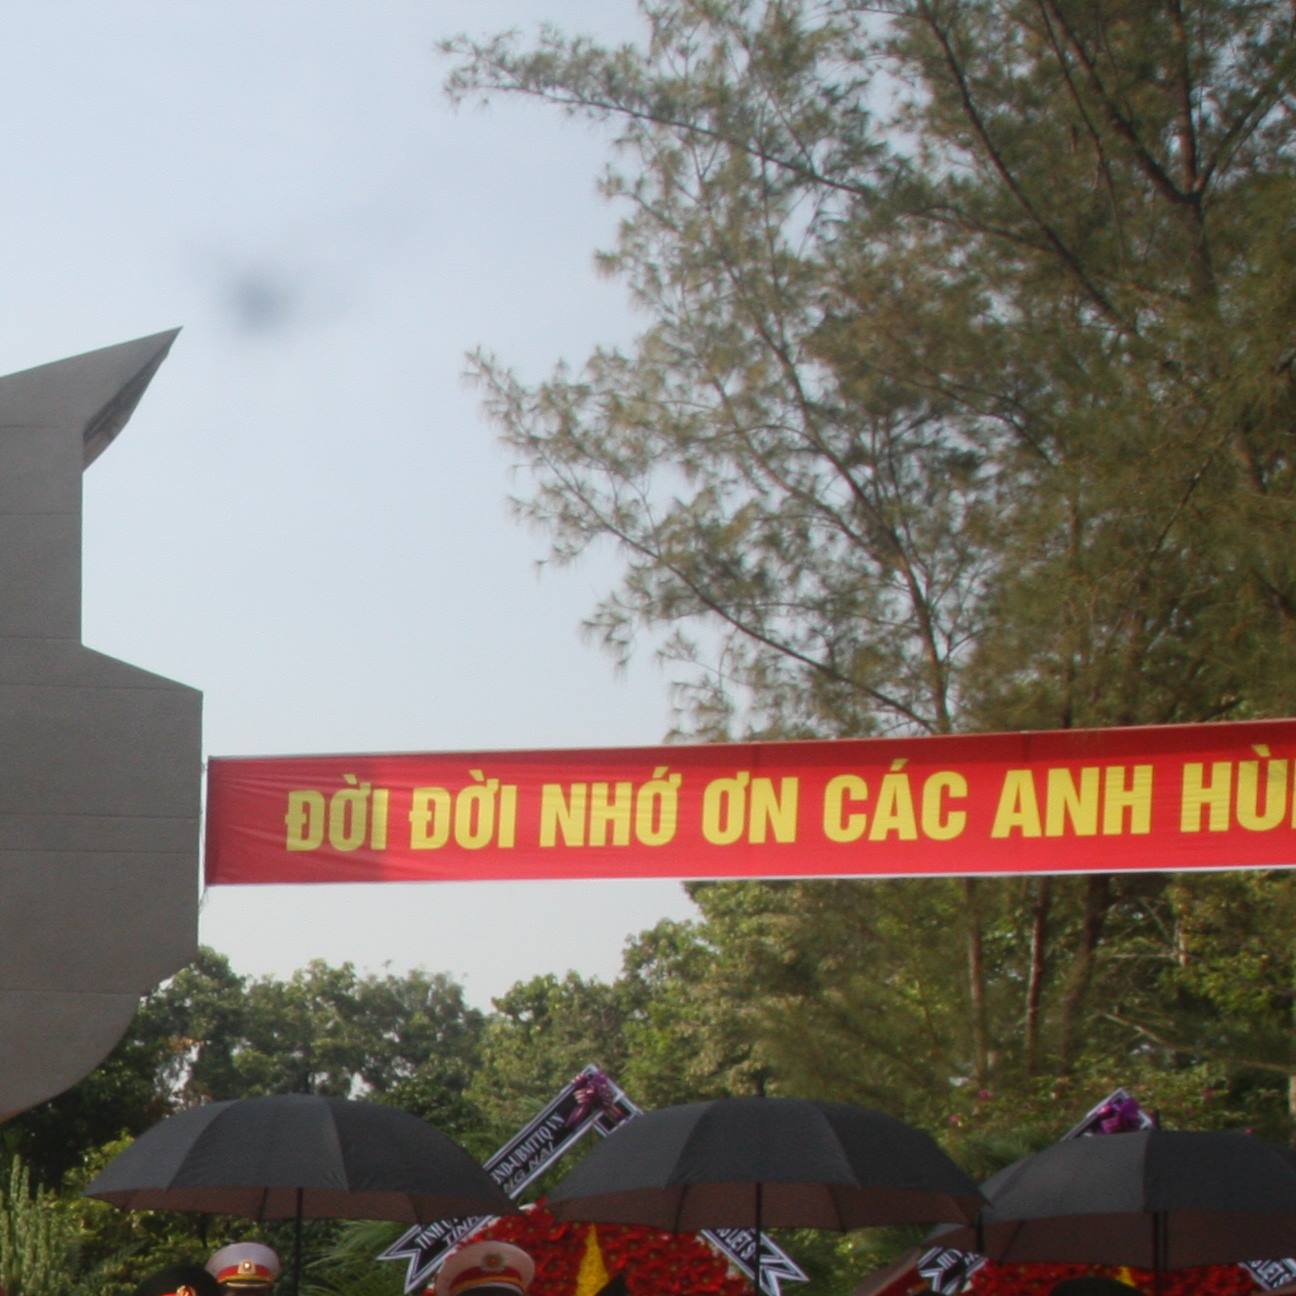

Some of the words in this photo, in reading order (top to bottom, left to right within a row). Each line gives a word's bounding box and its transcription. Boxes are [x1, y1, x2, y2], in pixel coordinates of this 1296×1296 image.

[284, 773, 390, 852] ĐỜI
[409, 769, 518, 850] ĐỜI
[539, 766, 683, 848] NHỚ
[702, 771, 799, 845] ƠN
[823, 758, 969, 843] CÁC
[990, 764, 1154, 839] ANH
[1180, 743, 1296, 834] HÙ
